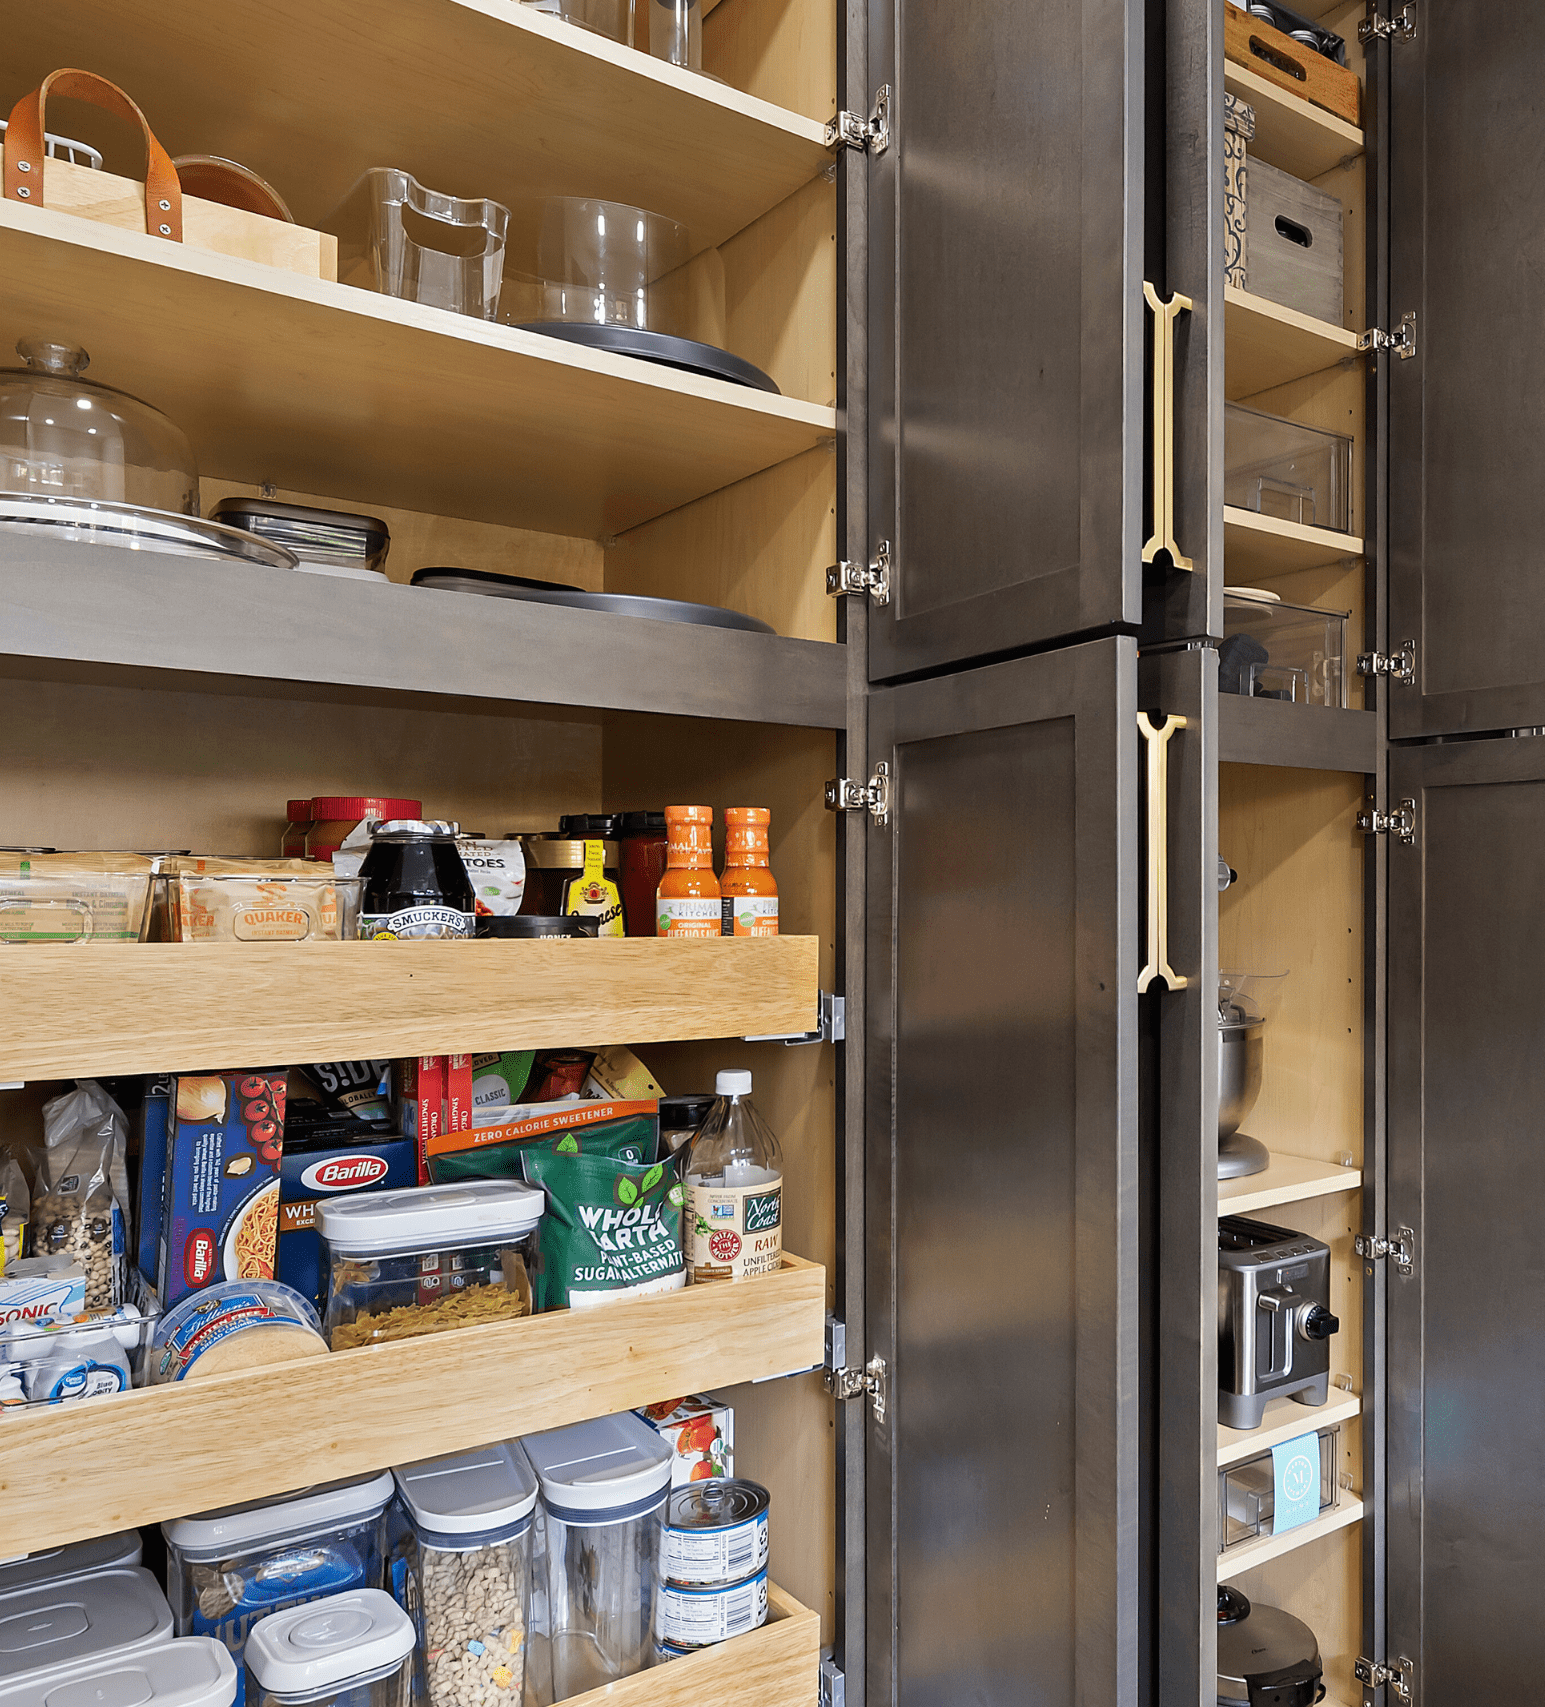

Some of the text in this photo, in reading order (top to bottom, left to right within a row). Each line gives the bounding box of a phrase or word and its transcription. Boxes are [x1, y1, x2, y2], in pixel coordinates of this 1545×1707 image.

[244, 912, 303, 925] QUAKER
[392, 912, 462, 929] SMUCKER'S
[474, 1088, 506, 1106] CLASSIC
[474, 1107, 614, 1143] ZERO CALORIE SWEETENER
[322, 1160, 382, 1182] Barilla
[748, 1210, 779, 1230] Coast
[712, 1232, 734, 1243] WITH
[755, 1234, 778, 1252] RAW
[194, 1239, 208, 1280] Barilla
[712, 1242, 739, 1260] MOTHER
[743, 1266, 766, 1276] APPLE
[188, 1318, 228, 1352] GLUTEN
[231, 1309, 262, 1322] FREE
[200, 1318, 250, 1346] ORIGINAL
[200, 1332, 224, 1352] BREAD
[225, 1318, 258, 1334] CRUMBS
